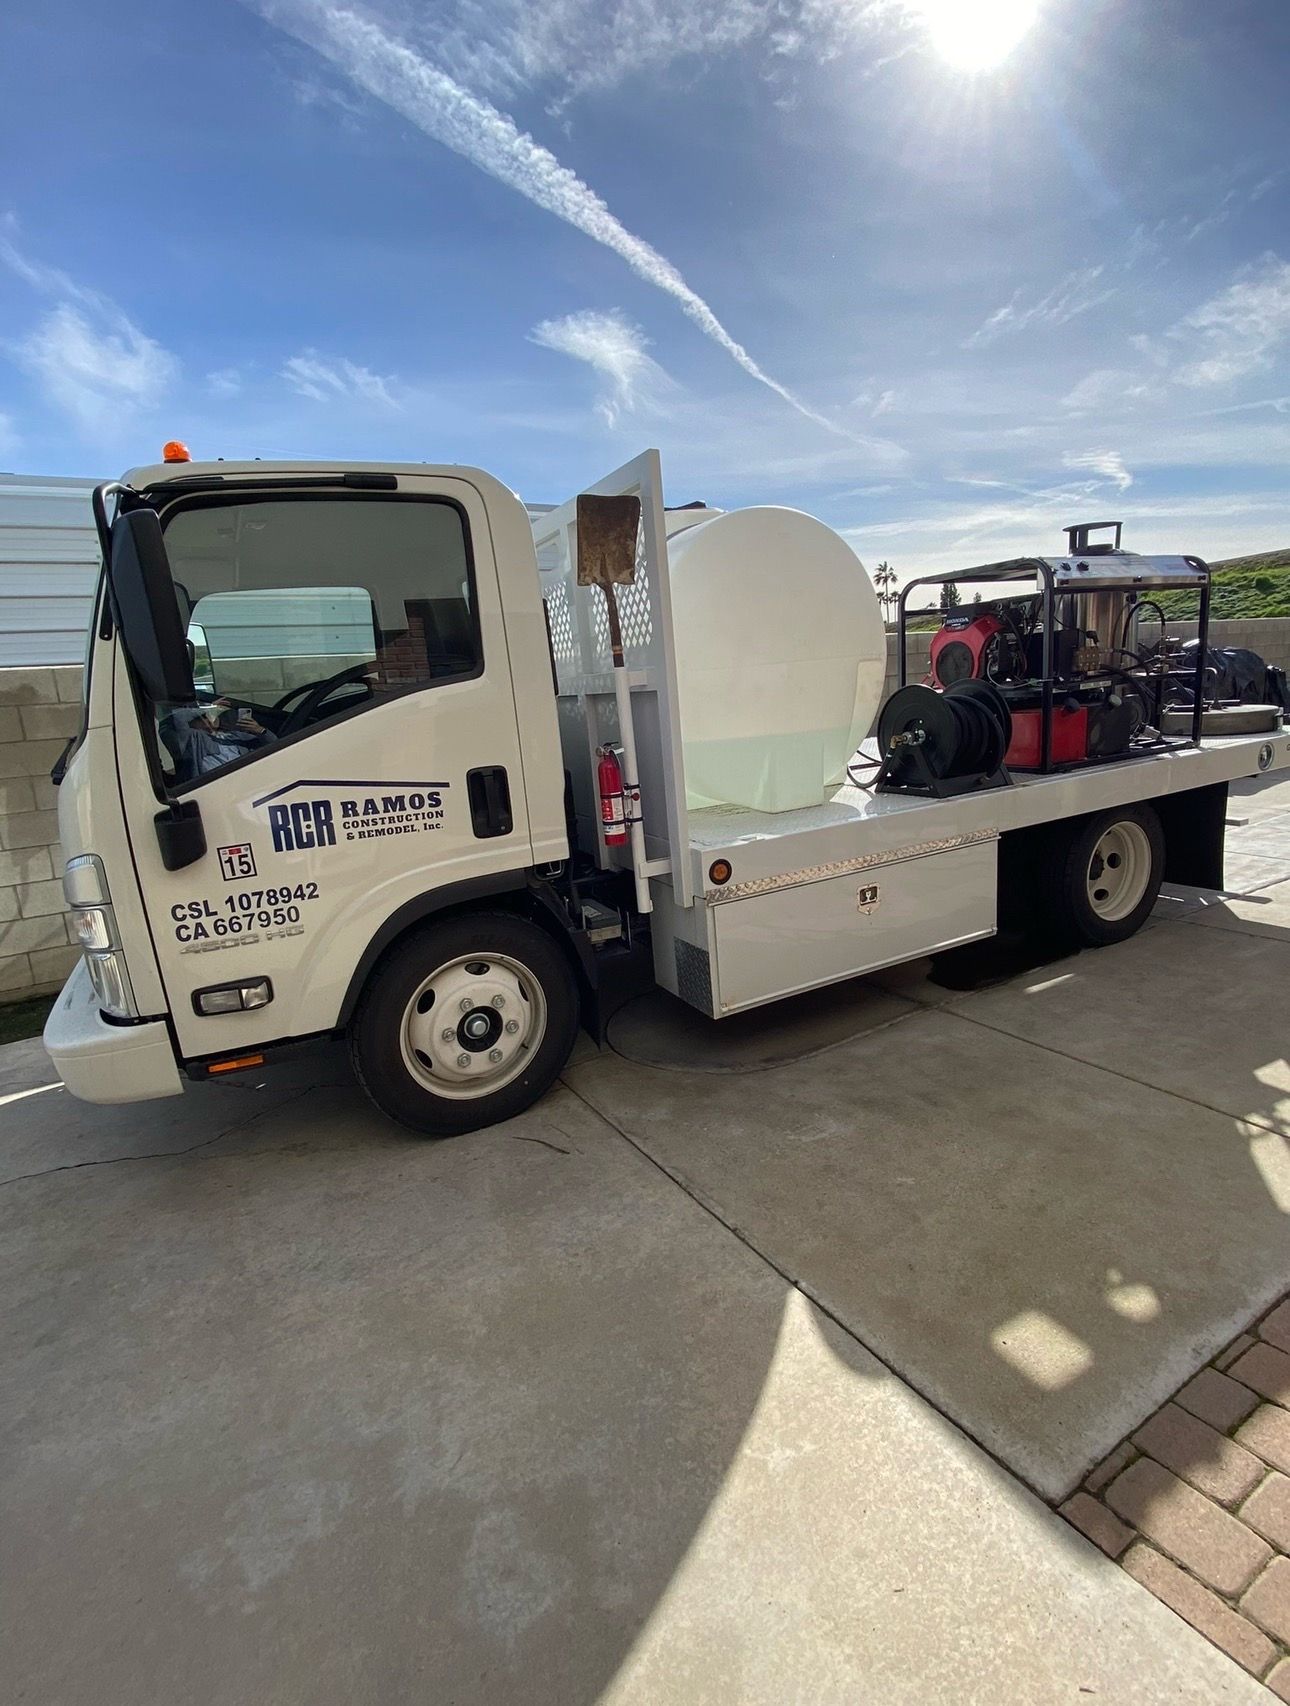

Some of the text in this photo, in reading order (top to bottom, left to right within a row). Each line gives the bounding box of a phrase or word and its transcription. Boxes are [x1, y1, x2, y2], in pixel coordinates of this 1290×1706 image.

[341, 791, 442, 818] RAMOS
[343, 809, 444, 830] CONSTRUCTION
[346, 831, 355, 840] &
[423, 821, 444, 831] Inc.
[224, 854, 252, 876] 15
[171, 882, 319, 922] CSL 1078942
[175, 905, 300, 942] CA 667950
